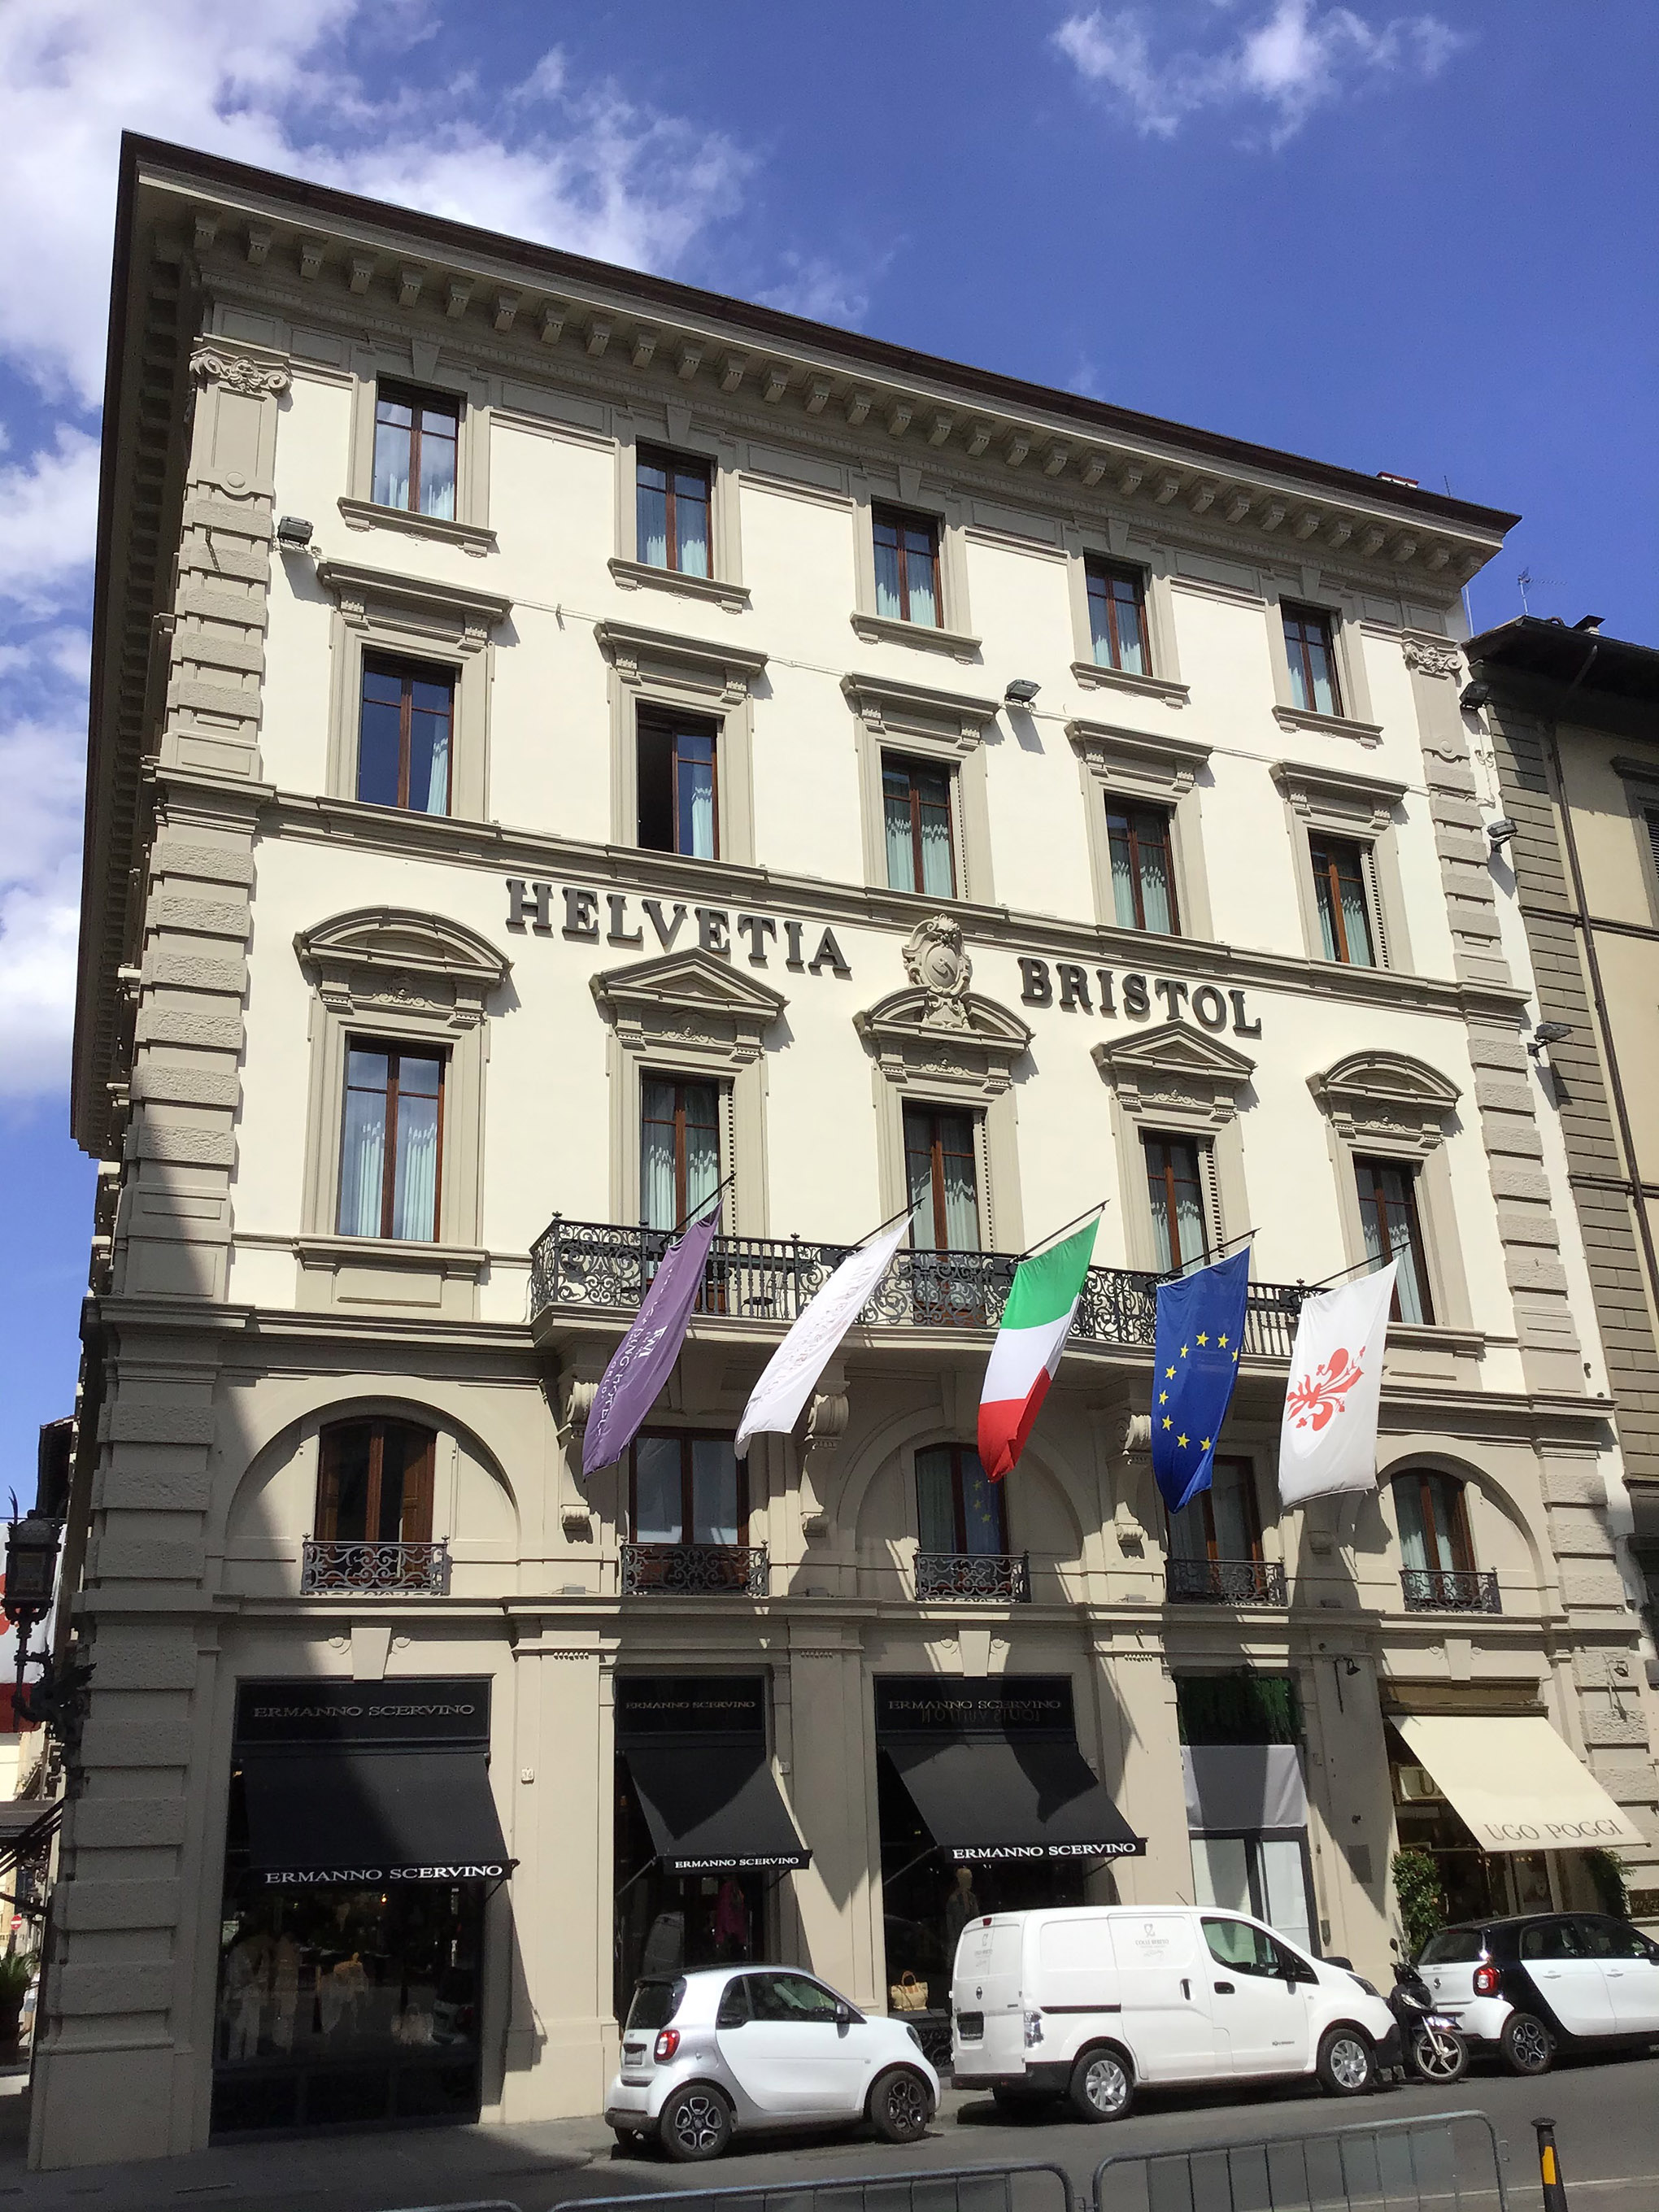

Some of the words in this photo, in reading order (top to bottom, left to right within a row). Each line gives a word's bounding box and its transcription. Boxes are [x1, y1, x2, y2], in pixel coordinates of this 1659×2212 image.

[506, 878, 851, 973] HELVETIA
[1017, 956, 1261, 1033] BRISTOL
[254, 1707, 364, 1718] ERMANNO
[368, 1705, 475, 1717] SCERVINO
[626, 1701, 690, 1709] ERMANNO
[692, 1700, 755, 1709] SCERVINO
[889, 1700, 973, 1709] ERMANNO
[978, 1700, 1060, 1709] SCERVINO
[1484, 1822, 1539, 1841] UGO
[1544, 1819, 1624, 1840] POGGI
[952, 1846, 1043, 1859] ERMANNO
[1048, 1843, 1136, 1857] SCERVINO
[675, 1859, 736, 1869] ERMANNO
[739, 1857, 799, 1866] SCERVINO
[265, 1870, 382, 1884] ERMANNO
[390, 1866, 503, 1879] SCERVINO
